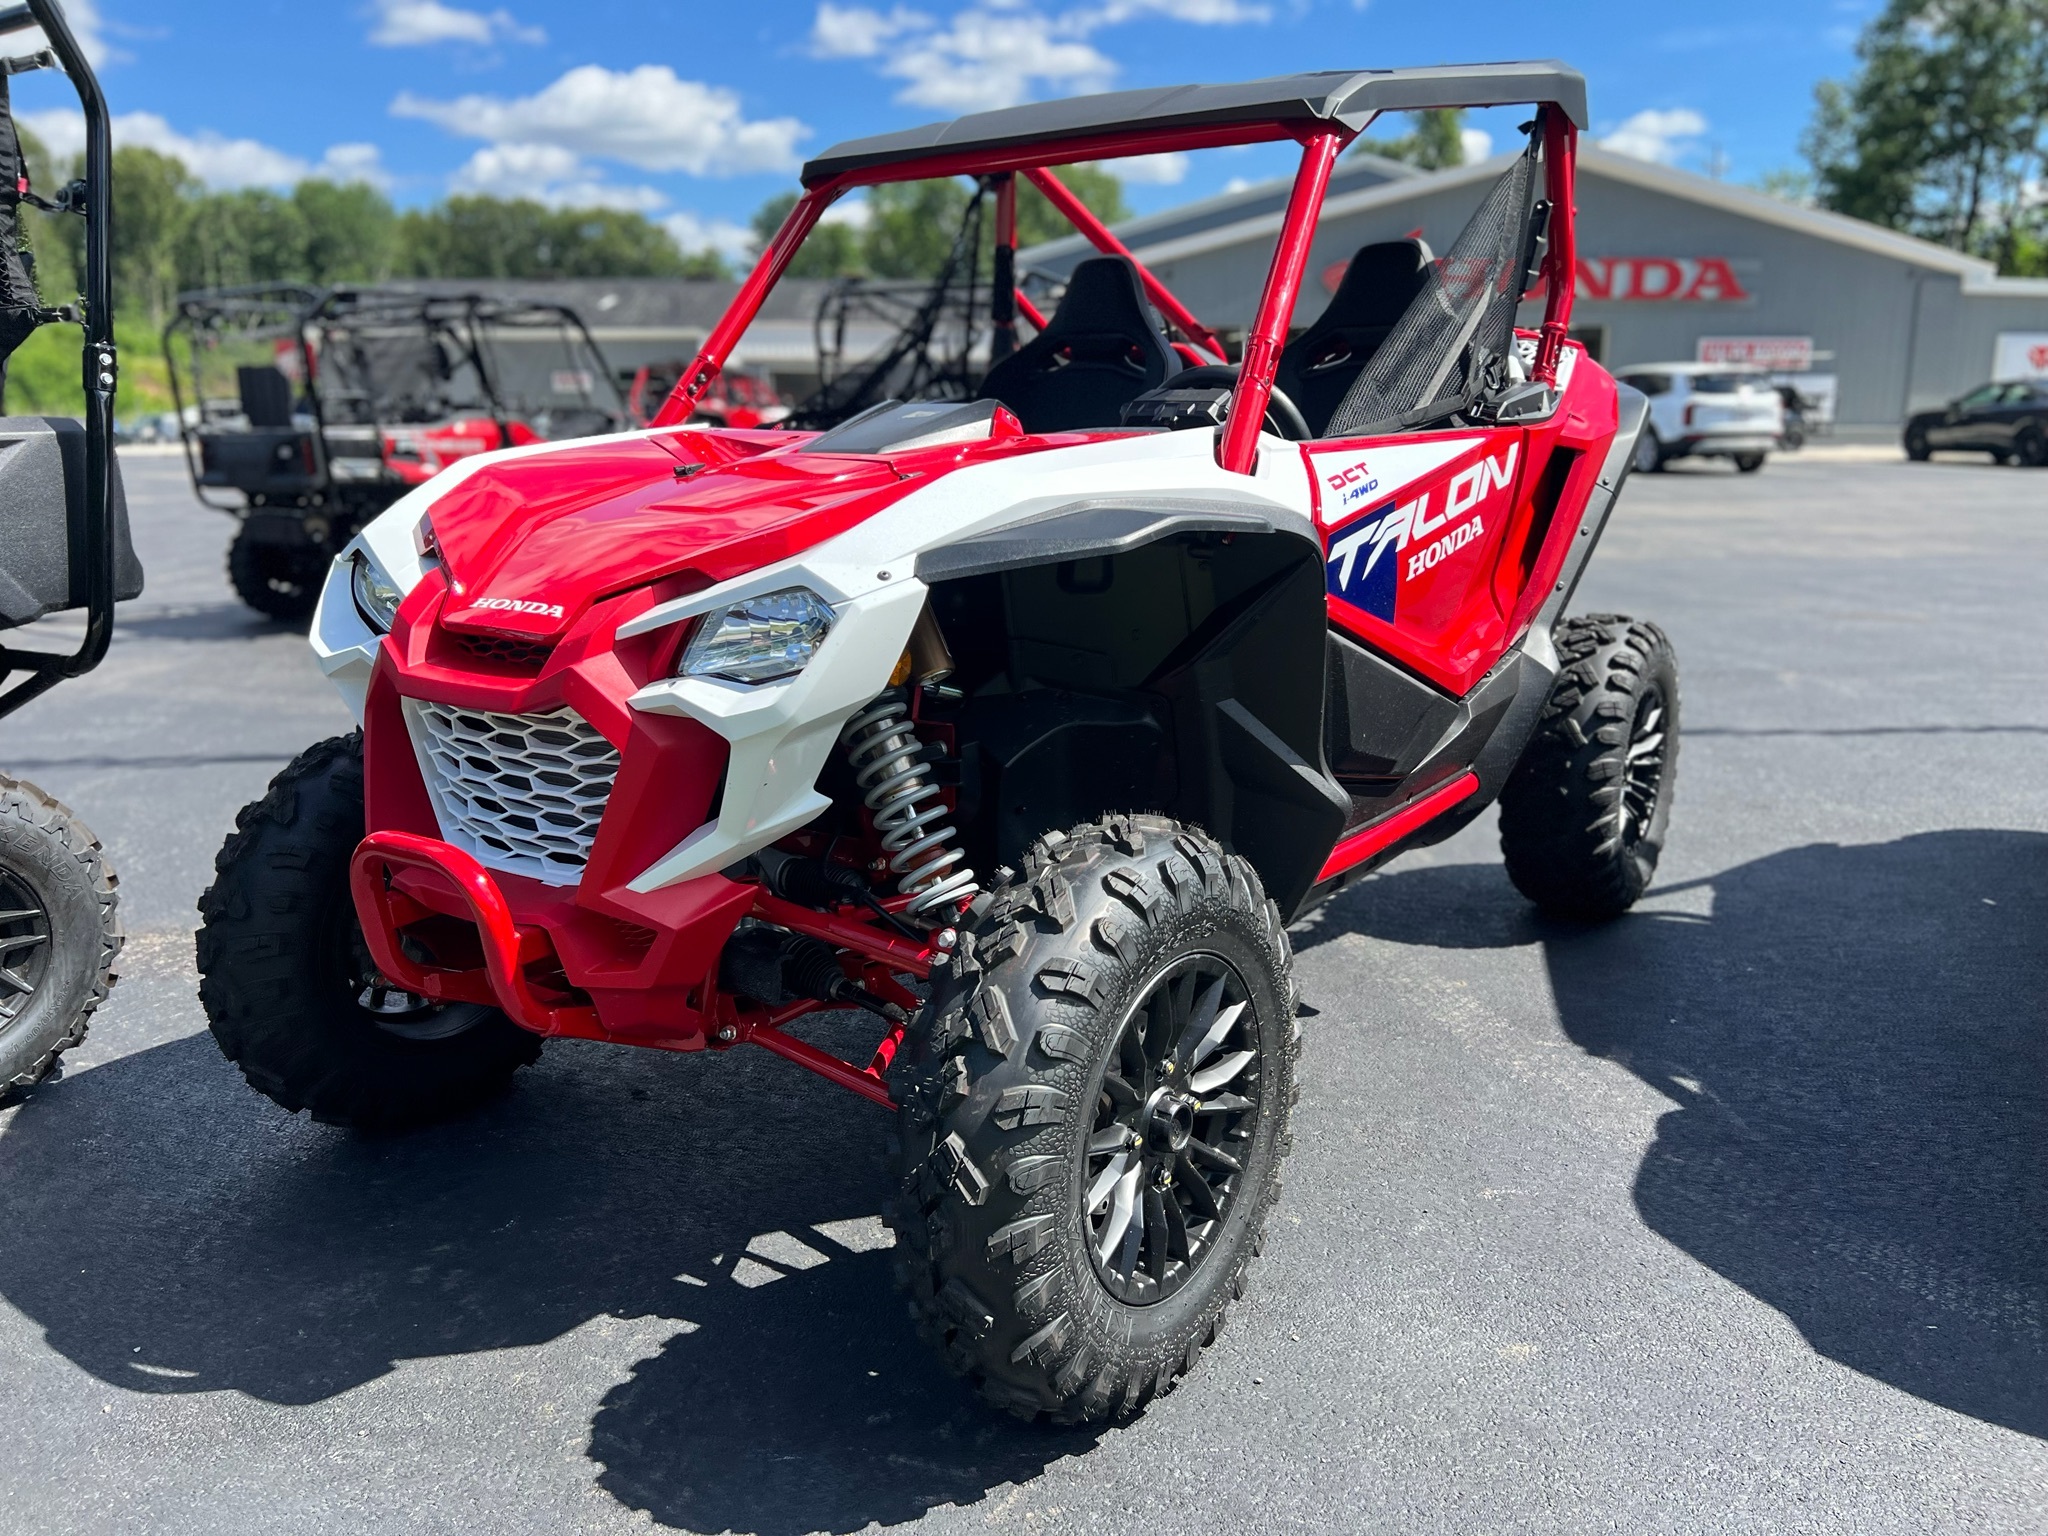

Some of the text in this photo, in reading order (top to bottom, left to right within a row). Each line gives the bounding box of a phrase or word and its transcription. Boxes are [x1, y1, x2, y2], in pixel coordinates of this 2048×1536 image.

[1327, 462, 1369, 491] DCT
[1327, 441, 1520, 592] TALON
[1406, 515, 1484, 582] HONDA
[468, 597, 565, 618] HONDA
